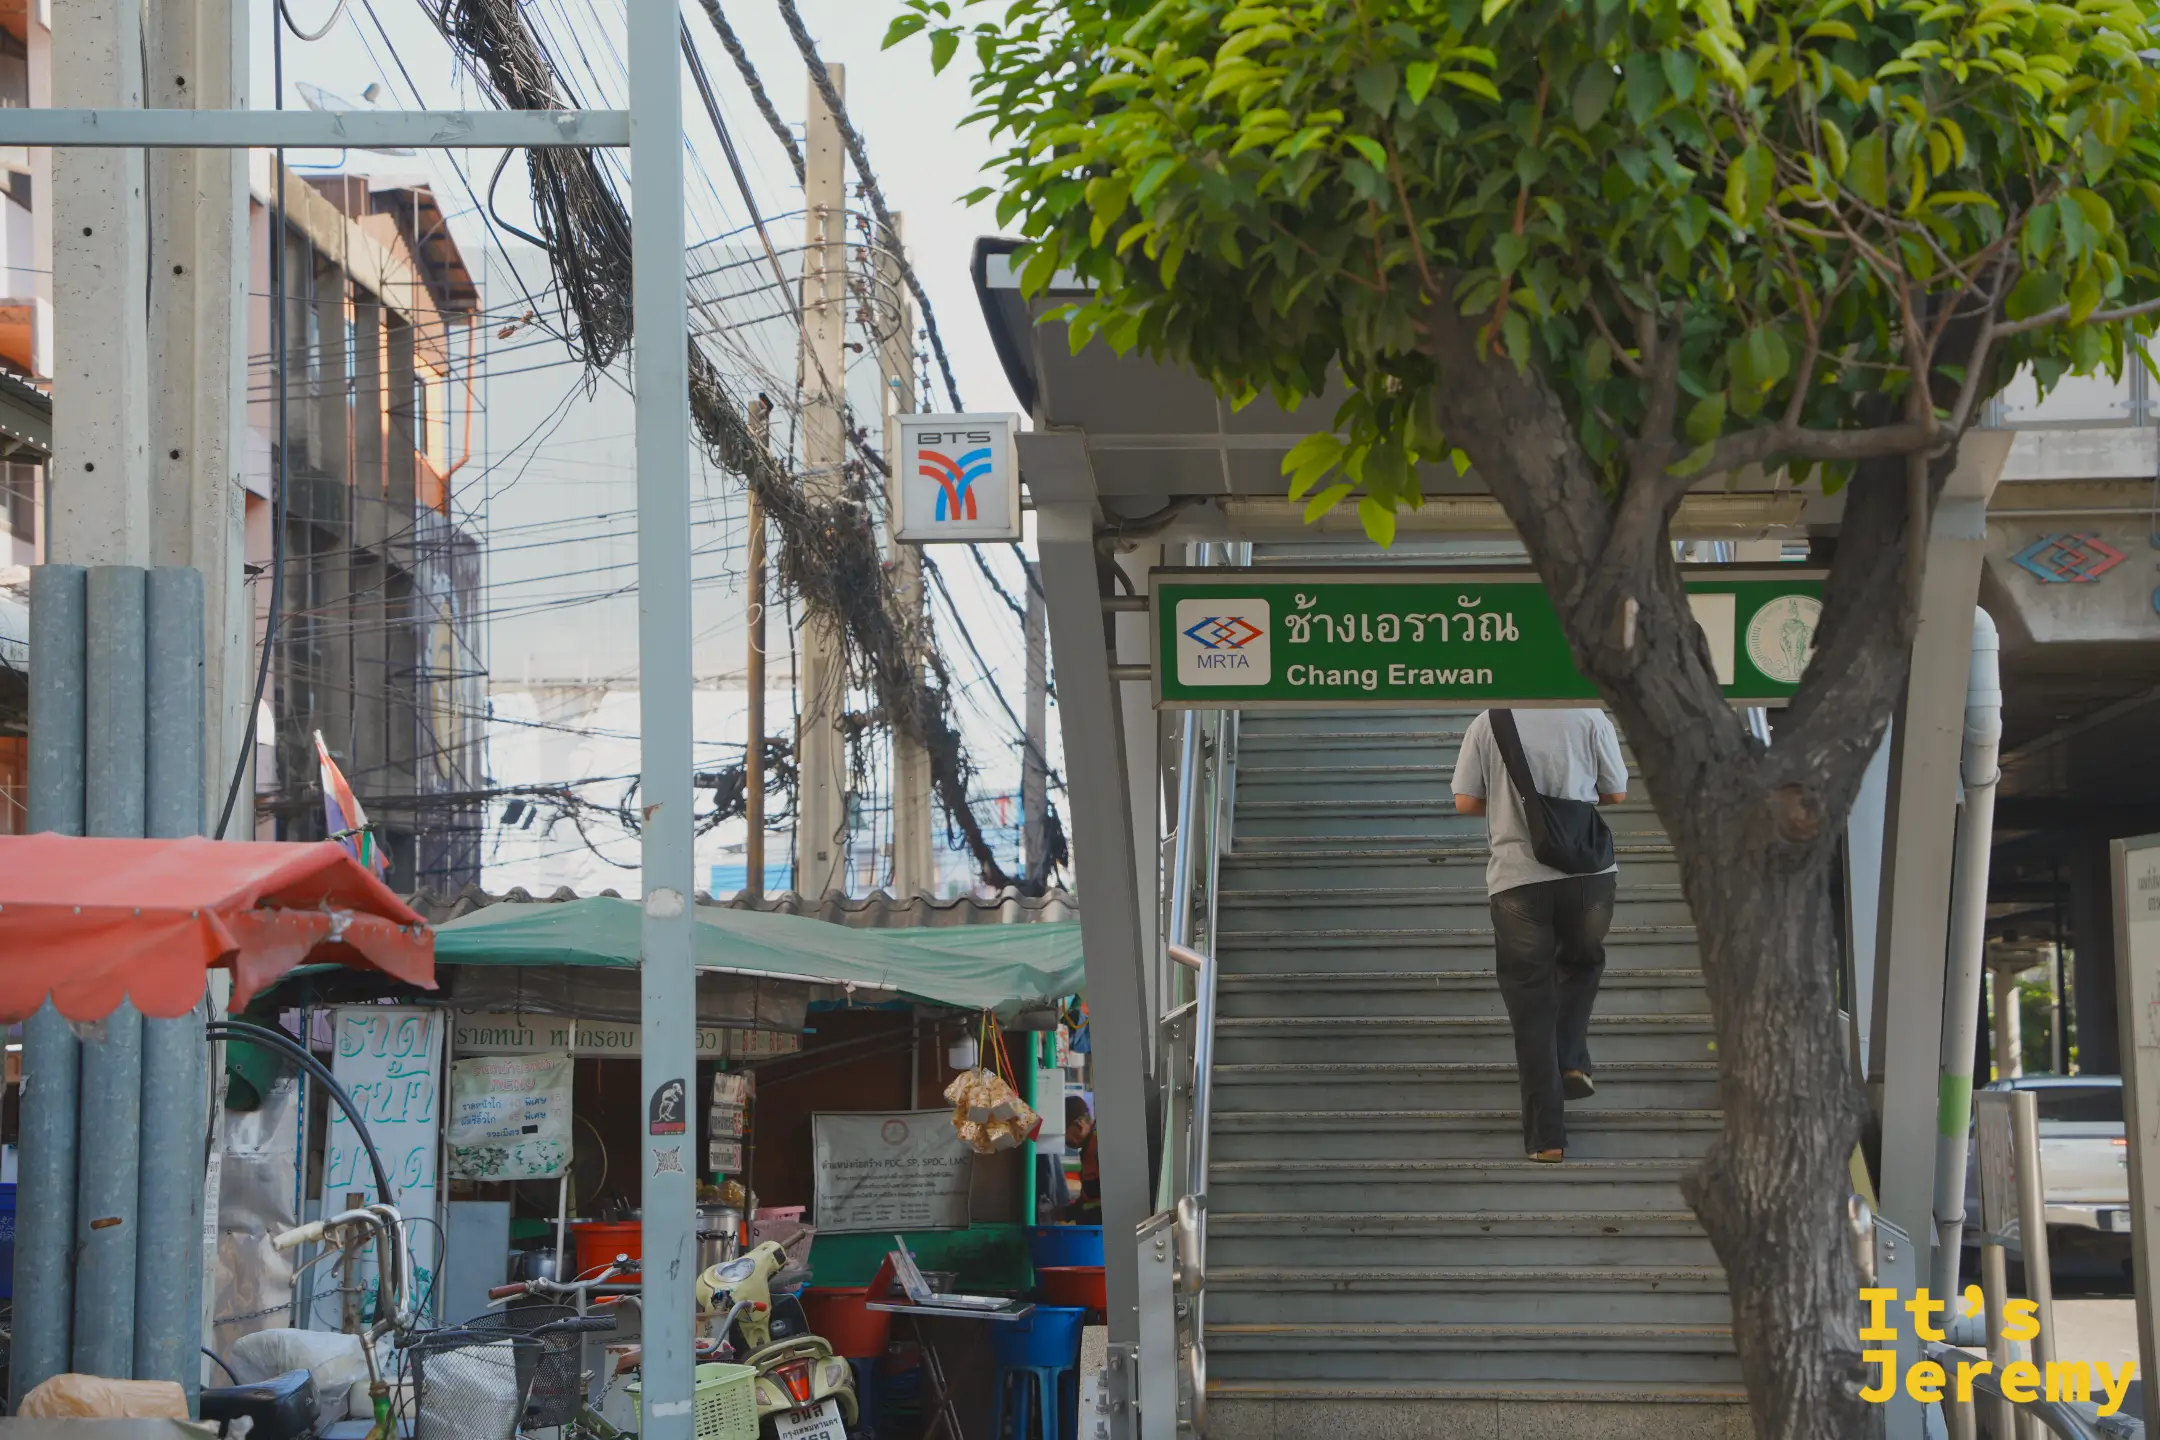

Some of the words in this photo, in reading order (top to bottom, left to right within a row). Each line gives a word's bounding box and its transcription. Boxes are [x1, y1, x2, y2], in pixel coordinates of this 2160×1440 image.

[917, 431, 991, 444] BTS
[1284, 593, 1520, 643] ช้างเอราวัณ
[1197, 654, 1250, 669] MRTA
[1287, 664, 1378, 691] Chang
[1388, 663, 1493, 685] Erawan
[490, 1079, 536, 1092] MENU
